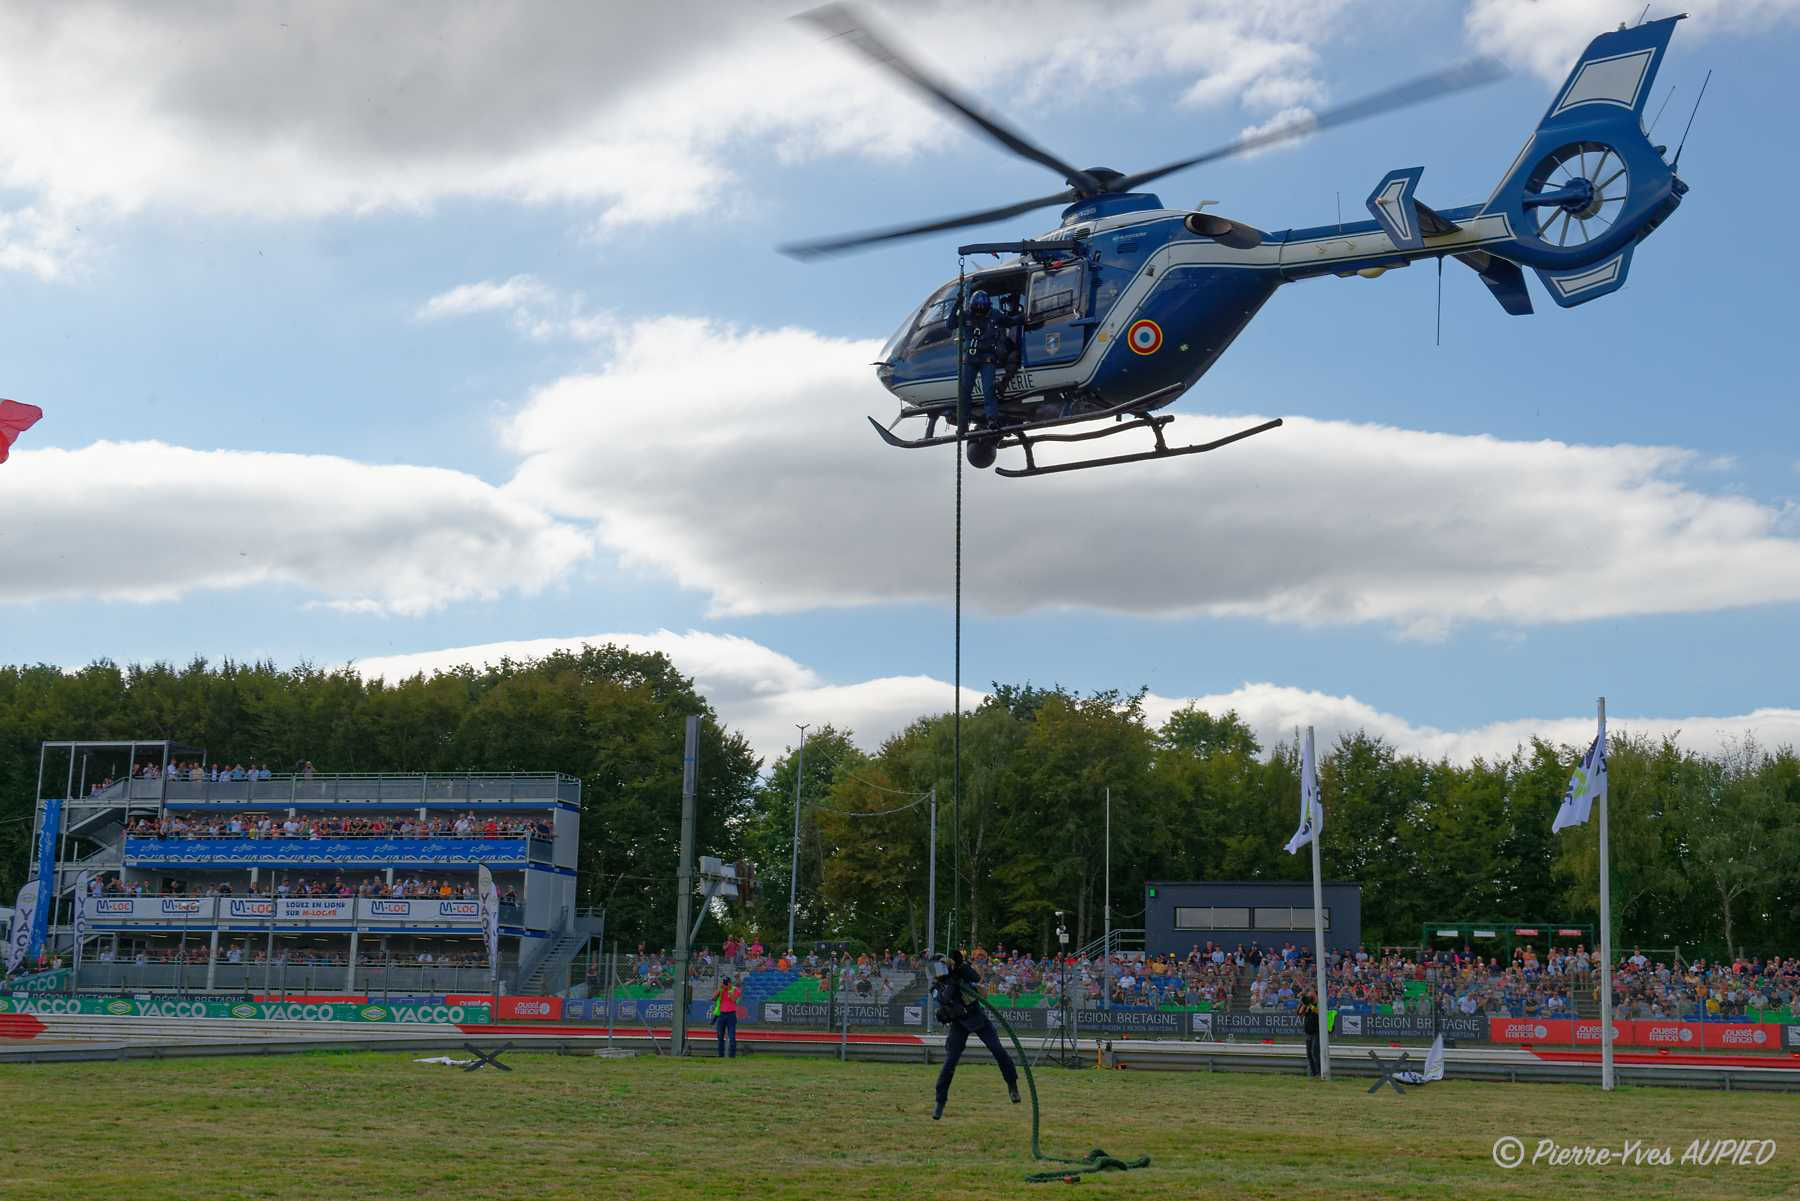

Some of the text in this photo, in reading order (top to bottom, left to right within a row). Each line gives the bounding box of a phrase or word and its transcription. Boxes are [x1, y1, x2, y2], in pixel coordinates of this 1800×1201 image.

[12, 999, 81, 1014] YACCO
[136, 1001, 207, 1018] YACCO
[260, 1003, 334, 1021] YACCO
[389, 1005, 465, 1023] YACCO
[1116, 1013, 1177, 1025] BRETAGNE
[1416, 1017, 1480, 1031] BRTAGNE
